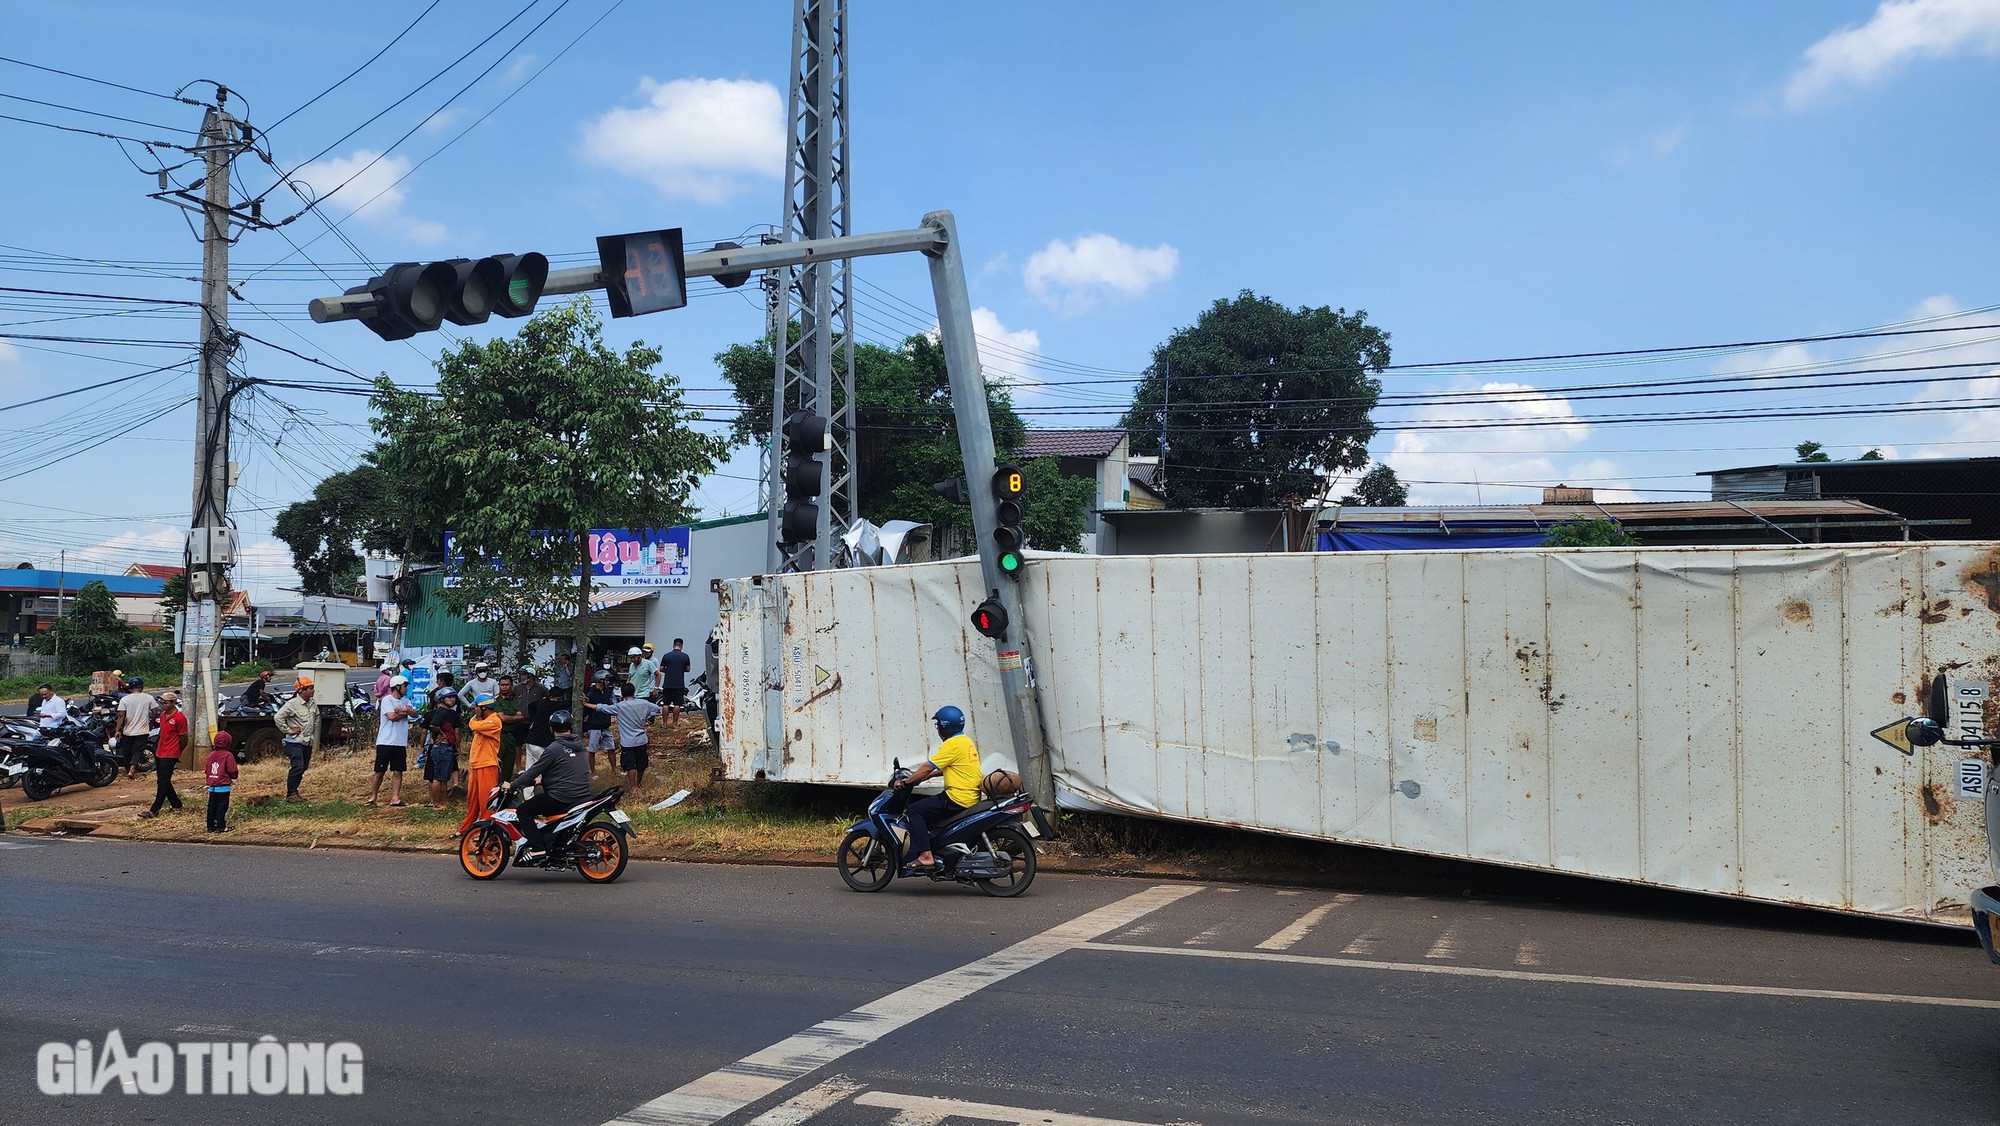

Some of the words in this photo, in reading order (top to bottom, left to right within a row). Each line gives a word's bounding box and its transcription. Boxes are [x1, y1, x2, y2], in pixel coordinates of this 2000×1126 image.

[1009, 473, 1022, 493] 8
[793, 646, 801, 663] ASIU
[1960, 688, 1981, 696] 8
[1961, 763, 1982, 794] ASIU
